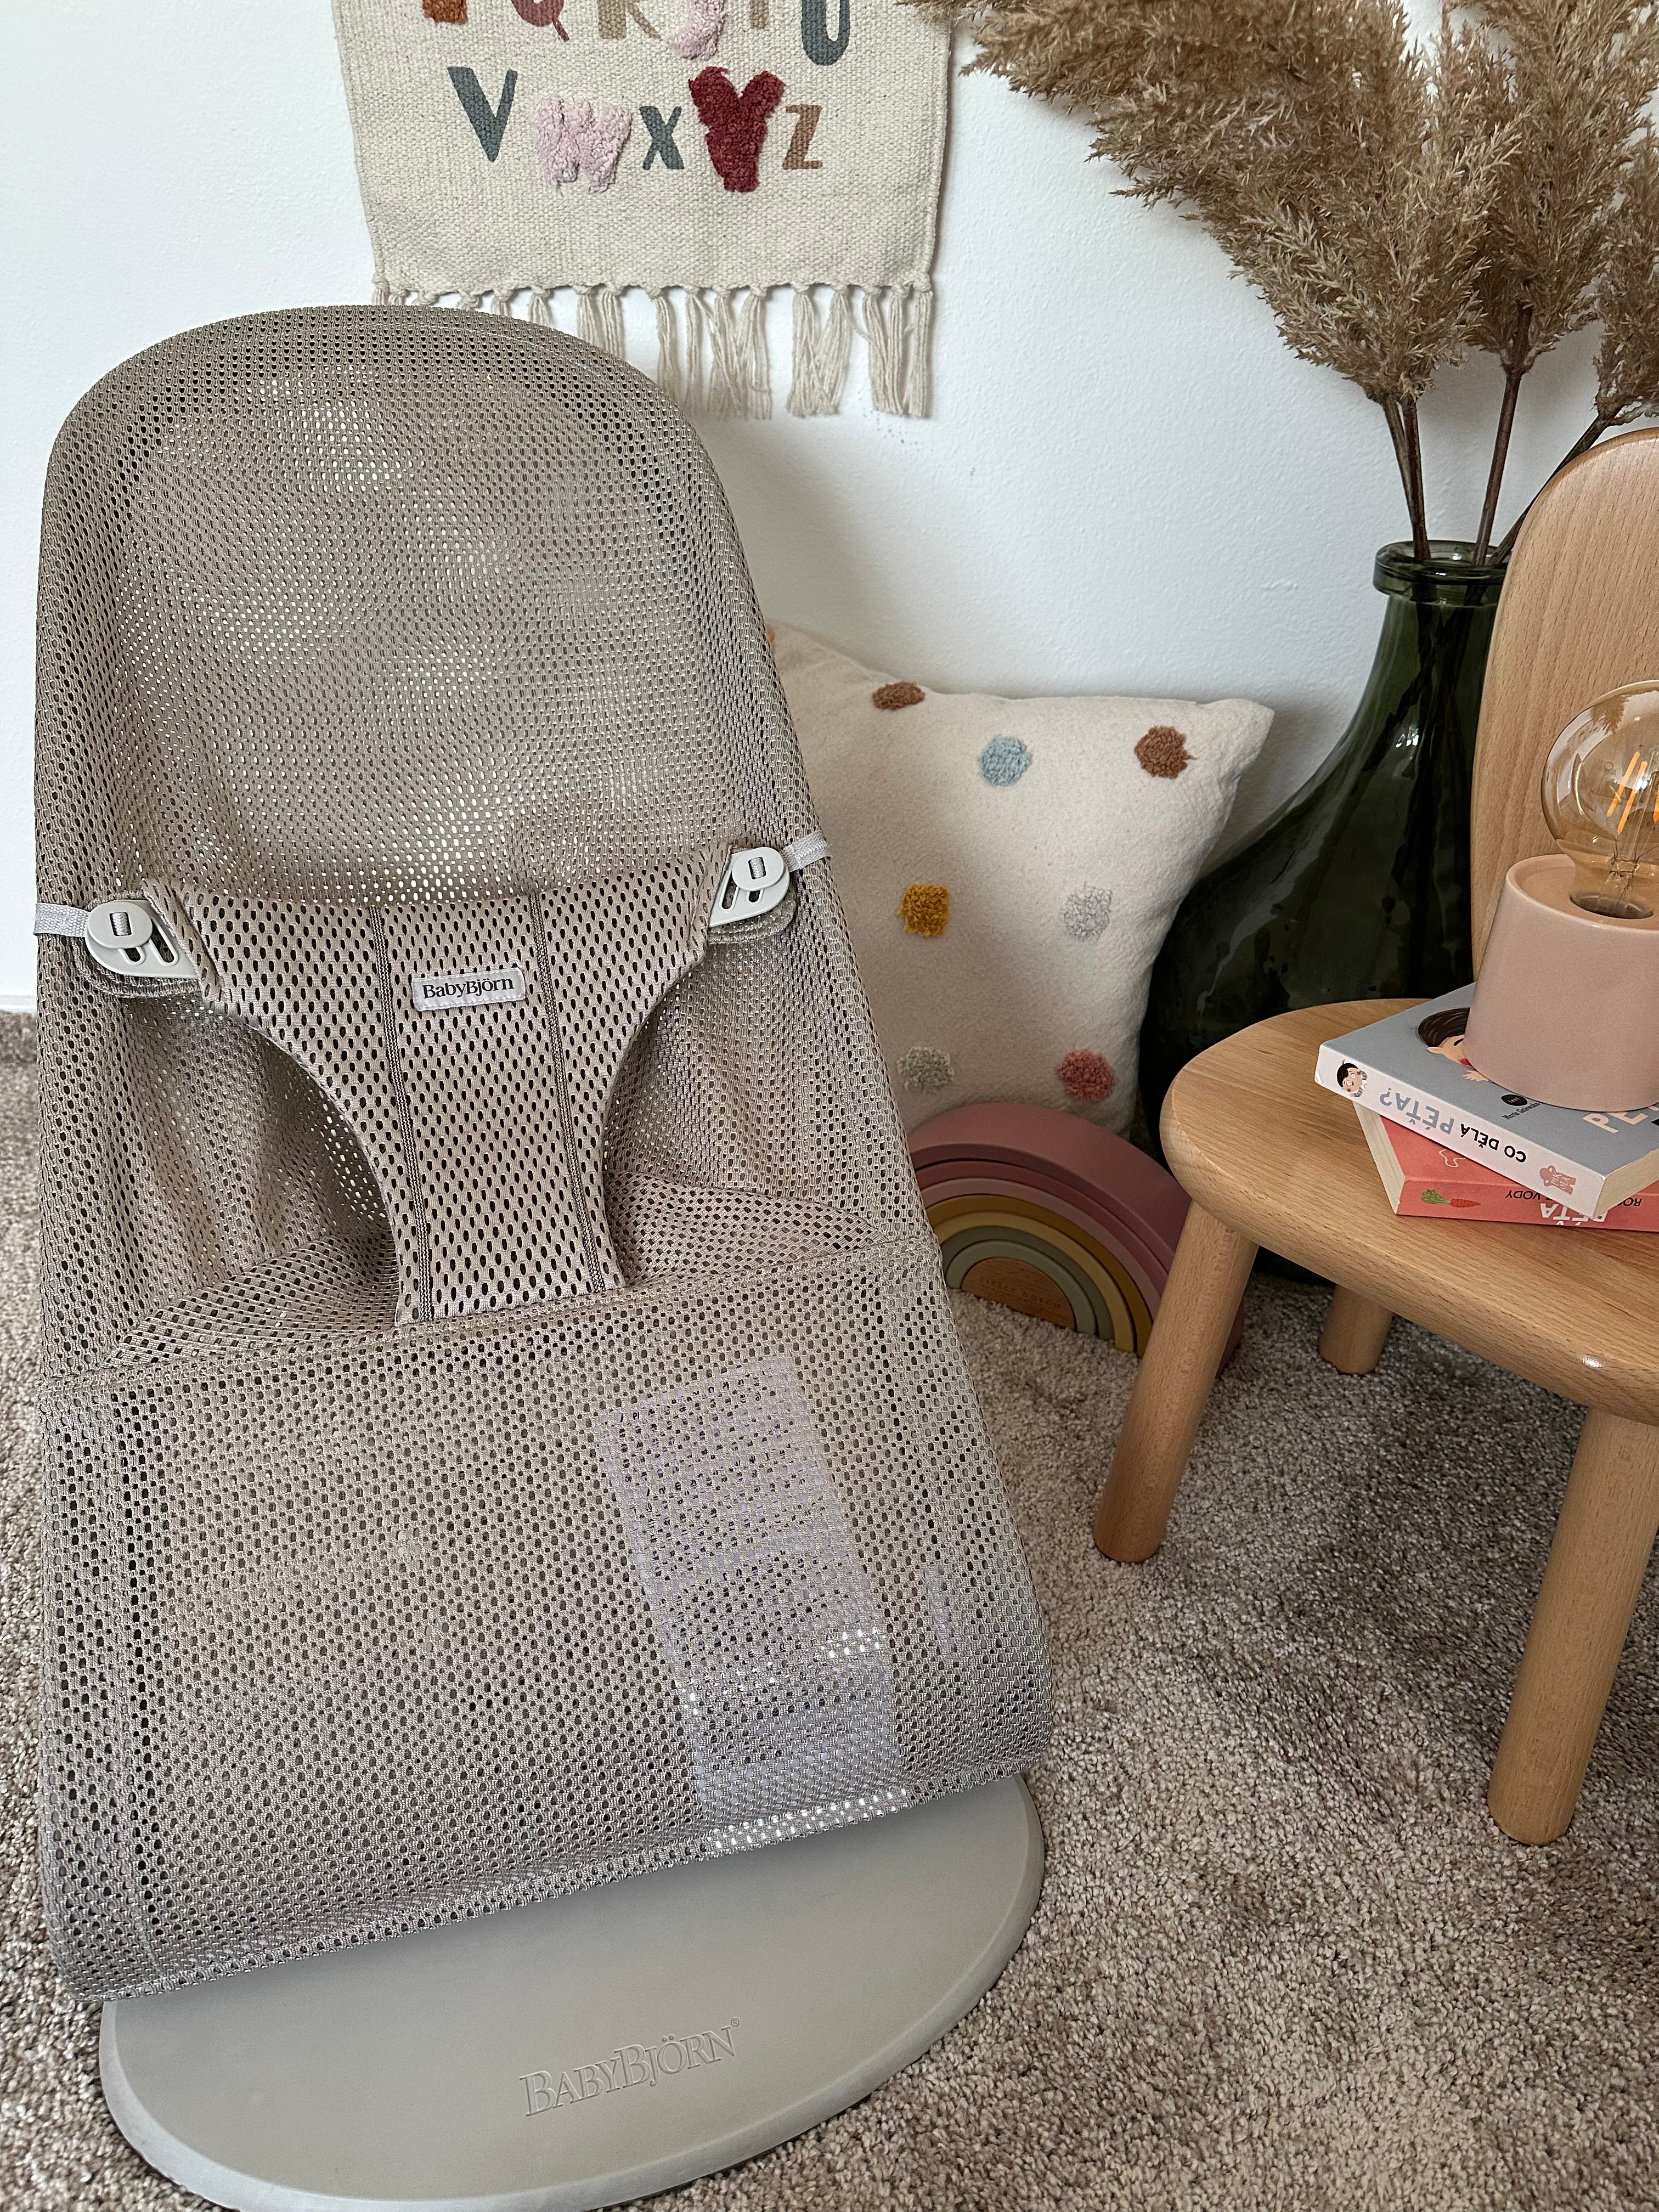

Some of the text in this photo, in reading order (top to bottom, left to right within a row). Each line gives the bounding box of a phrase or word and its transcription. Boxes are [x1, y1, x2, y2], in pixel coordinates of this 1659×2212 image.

[422, 978, 515, 998] BabyBjörn
[1379, 1088, 1526, 1163] CO DĚLÁ PÉŤA?
[1505, 1190, 1541, 1200] VODY
